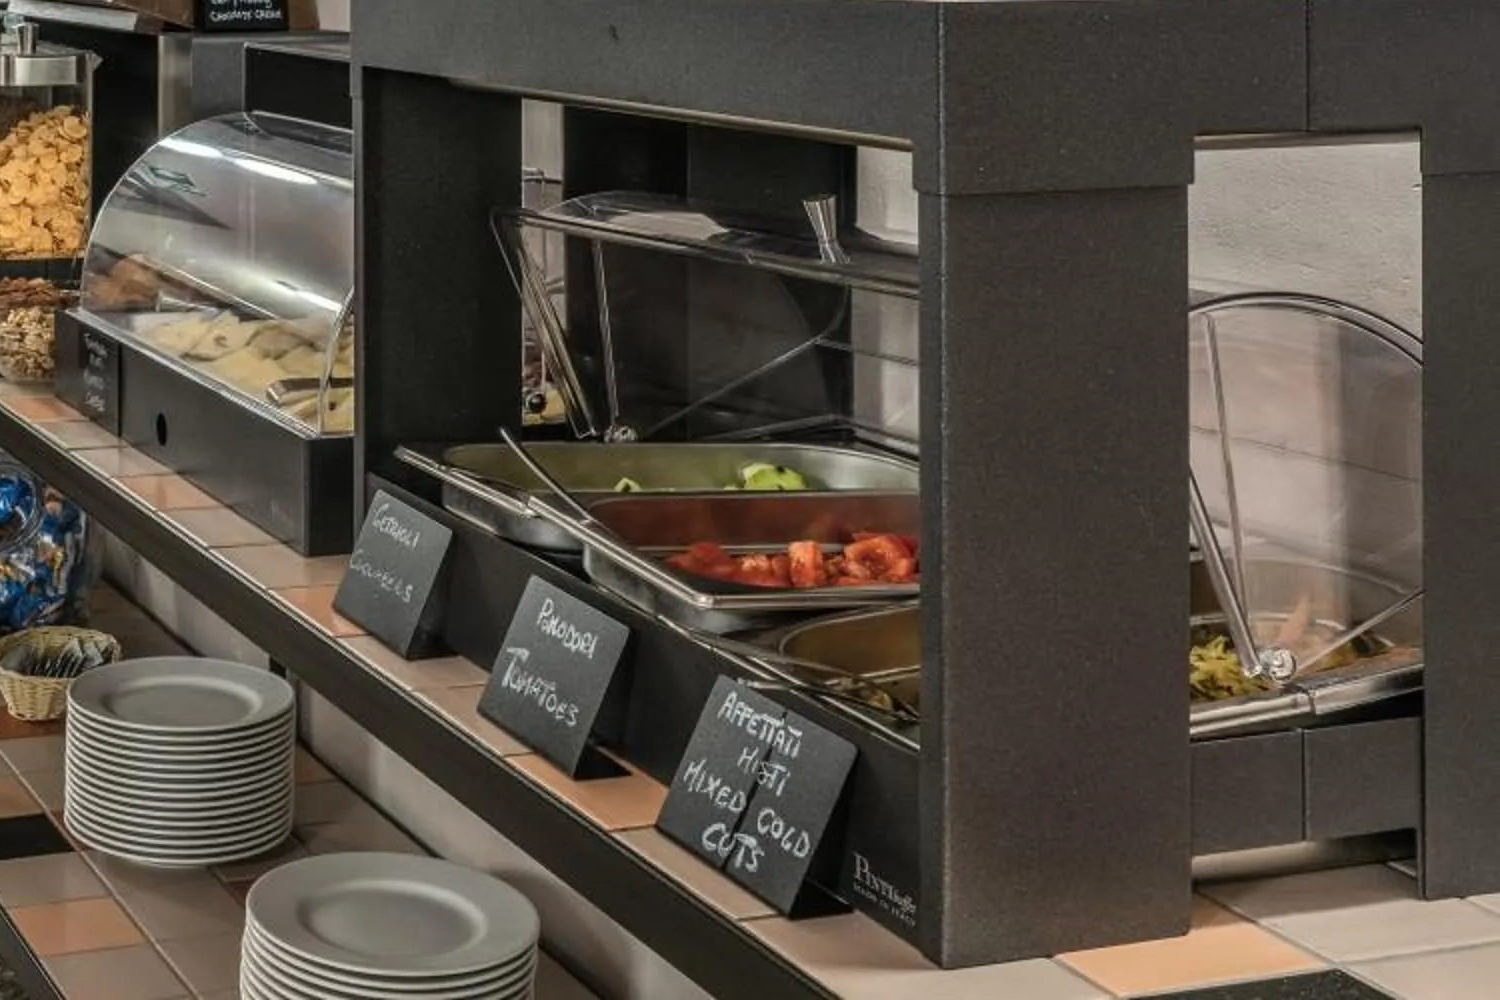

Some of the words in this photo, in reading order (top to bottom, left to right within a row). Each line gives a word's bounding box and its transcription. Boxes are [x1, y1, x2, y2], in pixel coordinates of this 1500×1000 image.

[683, 759, 748, 812] MIXED
[756, 807, 811, 858] COLD
[701, 822, 765, 873] CUTS
